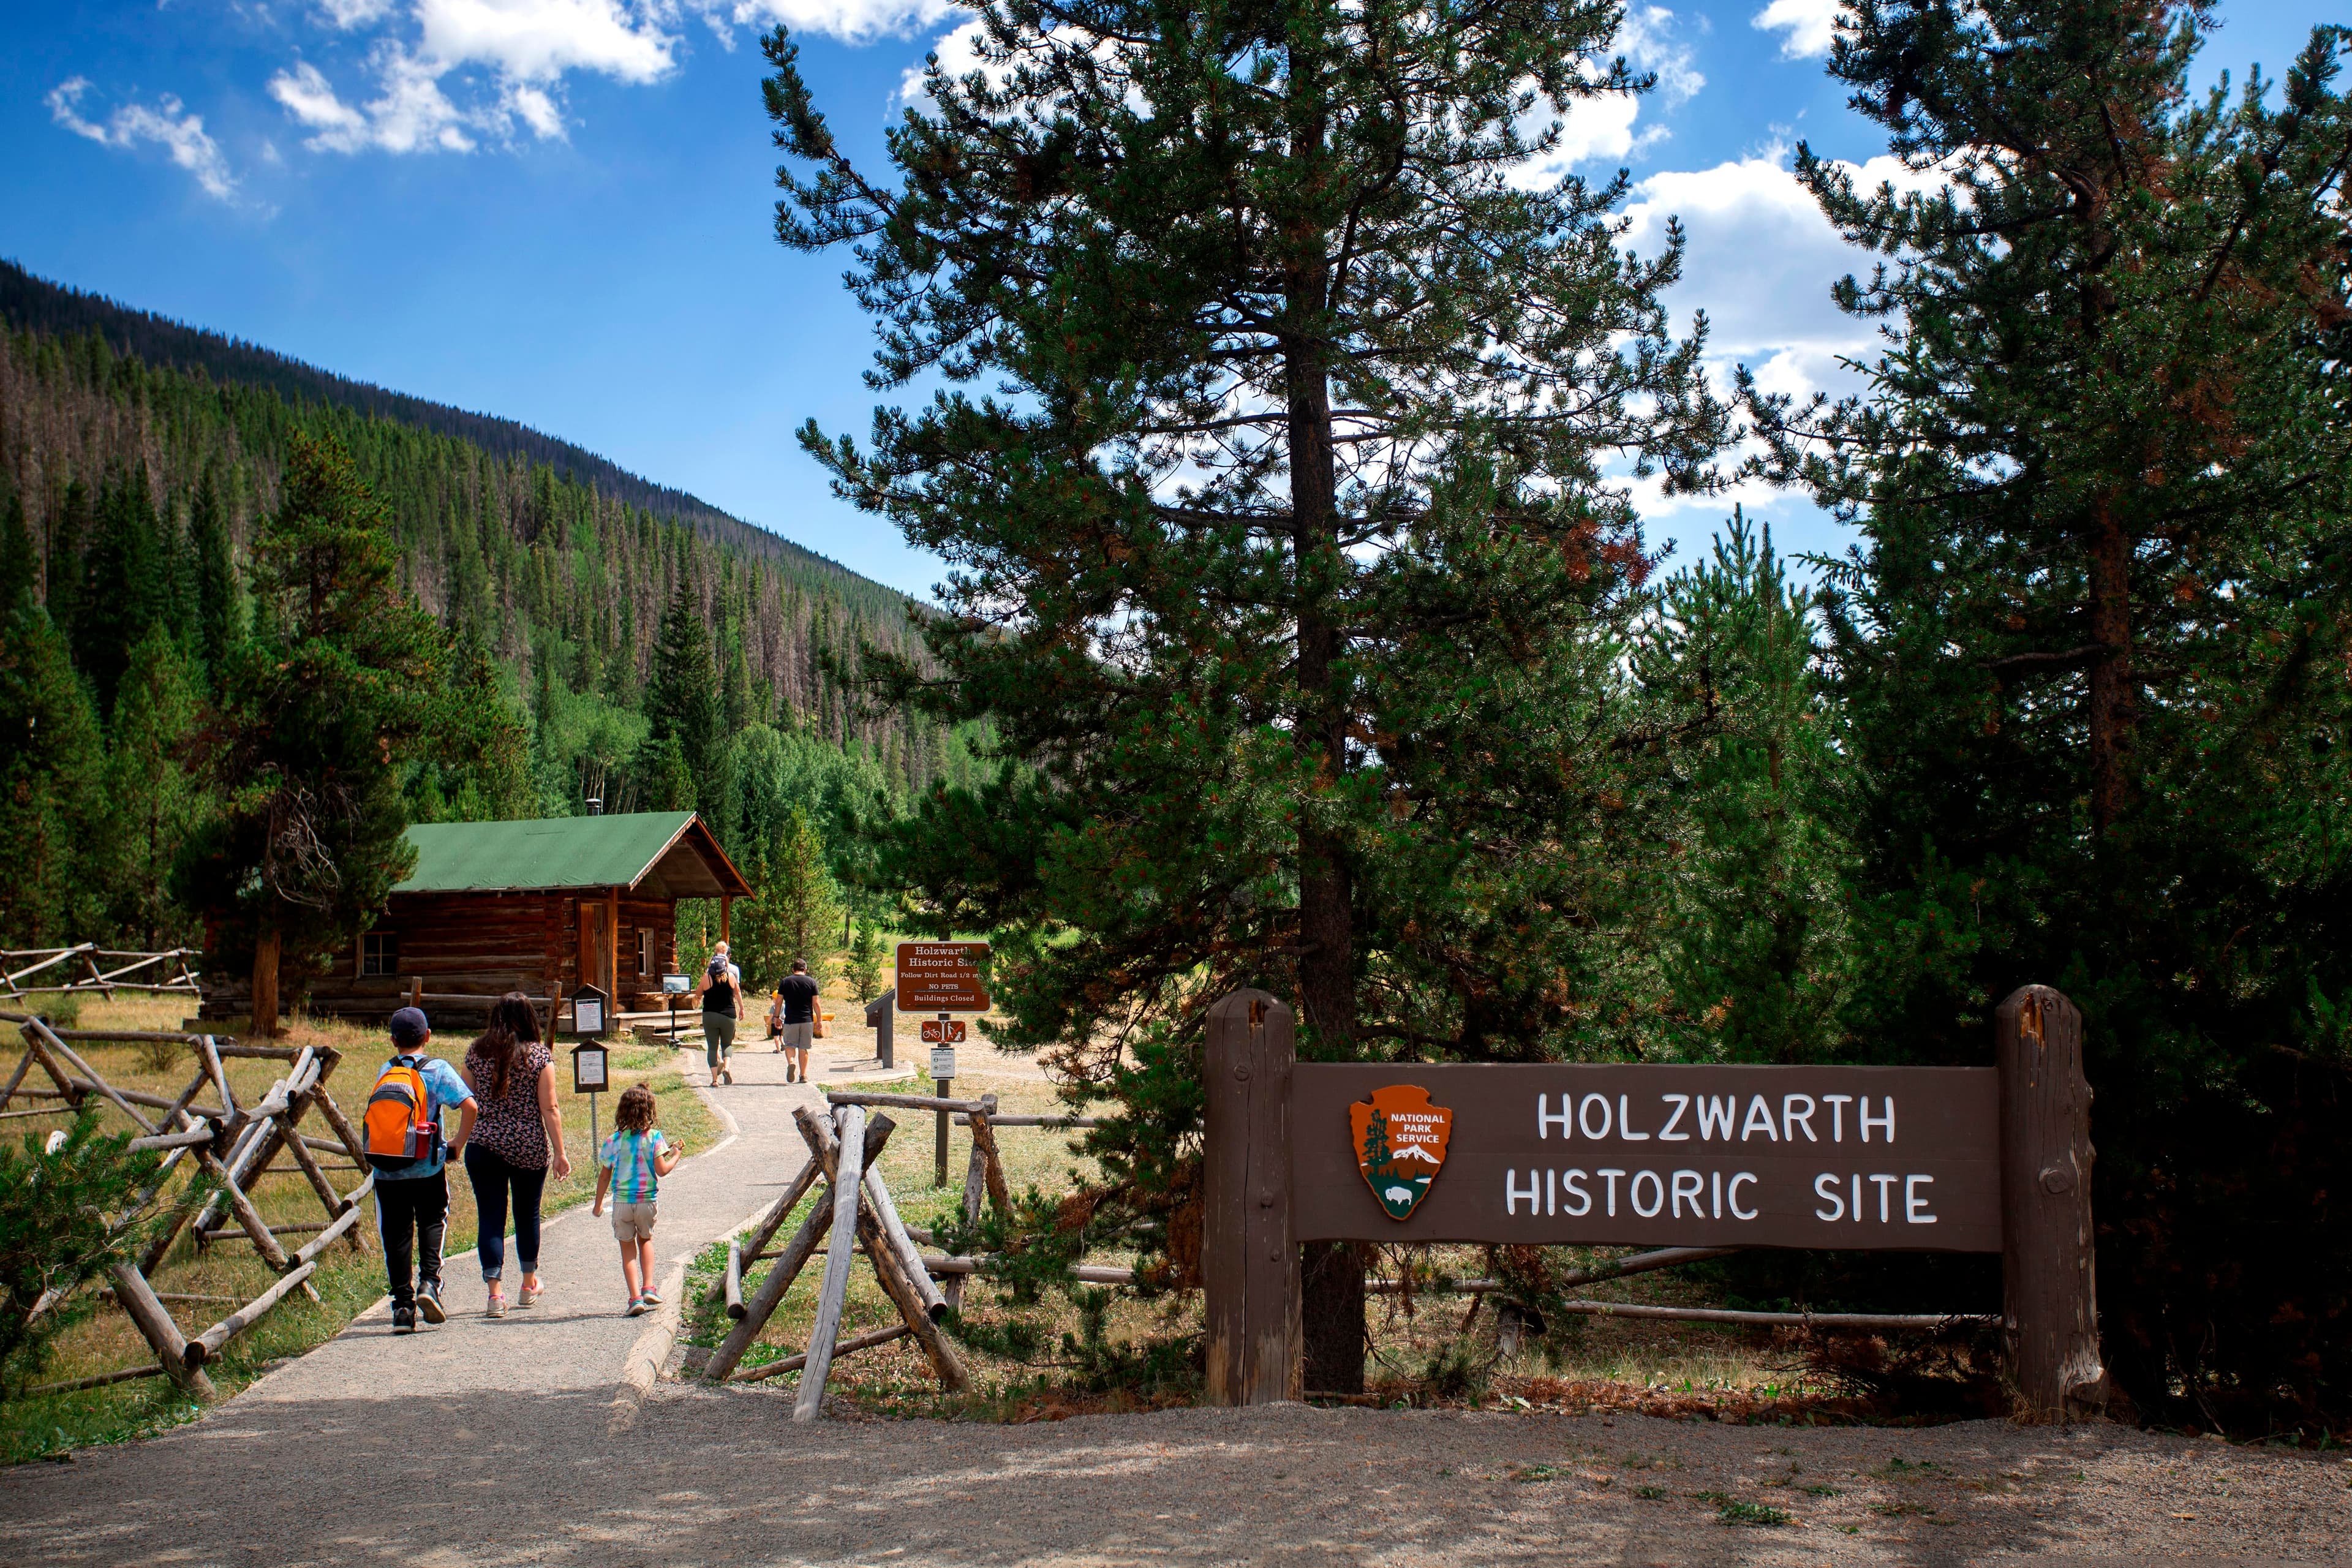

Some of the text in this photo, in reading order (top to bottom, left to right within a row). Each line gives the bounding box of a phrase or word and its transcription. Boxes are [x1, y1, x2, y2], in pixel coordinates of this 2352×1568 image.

[915, 946, 970, 955] Holzwarth
[909, 958, 953, 967] Historic
[1391, 1113, 1446, 1123] NATIONAL
[1539, 1093, 1896, 1143] HOLZWARTH
[1404, 1123, 1431, 1133] PARK
[1396, 1134, 1439, 1144] SERVICE
[1506, 1169, 1938, 1224] HISTORIC SITE
